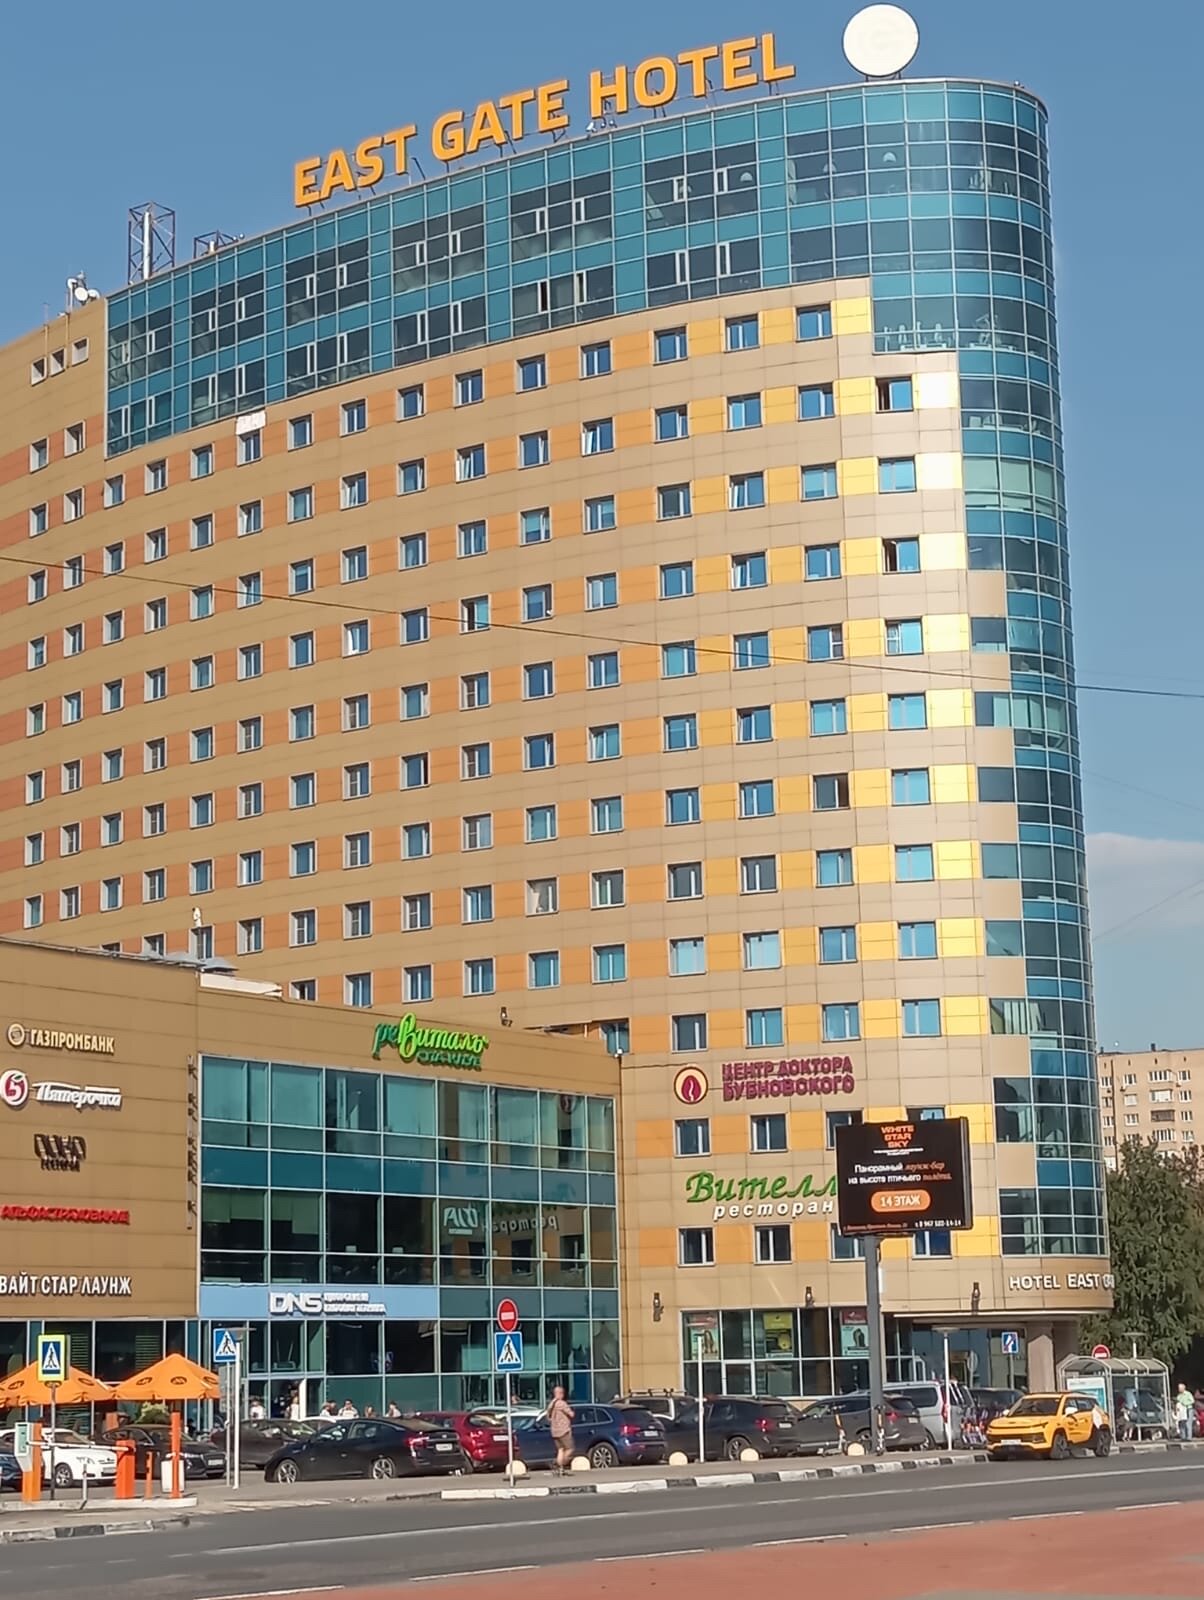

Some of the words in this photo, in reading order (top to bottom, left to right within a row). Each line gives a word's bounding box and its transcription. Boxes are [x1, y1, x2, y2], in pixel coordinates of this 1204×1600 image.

[294, 125, 416, 207] EAST
[432, 79, 569, 161] GATE
[590, 33, 796, 119] HOTEL
[31, 1029, 114, 1054] ГАЗПРОМБАНК
[721, 1061, 774, 1081] ЦЕНТР
[777, 1056, 853, 1077] ДОКТОРА
[722, 1075, 855, 1102] БУБНОВСКОГО
[686, 1171, 838, 1203] Вителл
[713, 1201, 834, 1221] ресторан
[880, 1196, 892, 1208] 14
[894, 1194, 921, 1207] ЭТАЖ
[0, 1272, 37, 1295] ВАЙТ
[41, 1276, 78, 1295] СТАР
[81, 1276, 132, 1295] ЛАУНЖ
[1010, 1275, 1062, 1289] HOTEL
[1068, 1273, 1100, 1288] EAST
[269, 1292, 323, 1313] DNS
